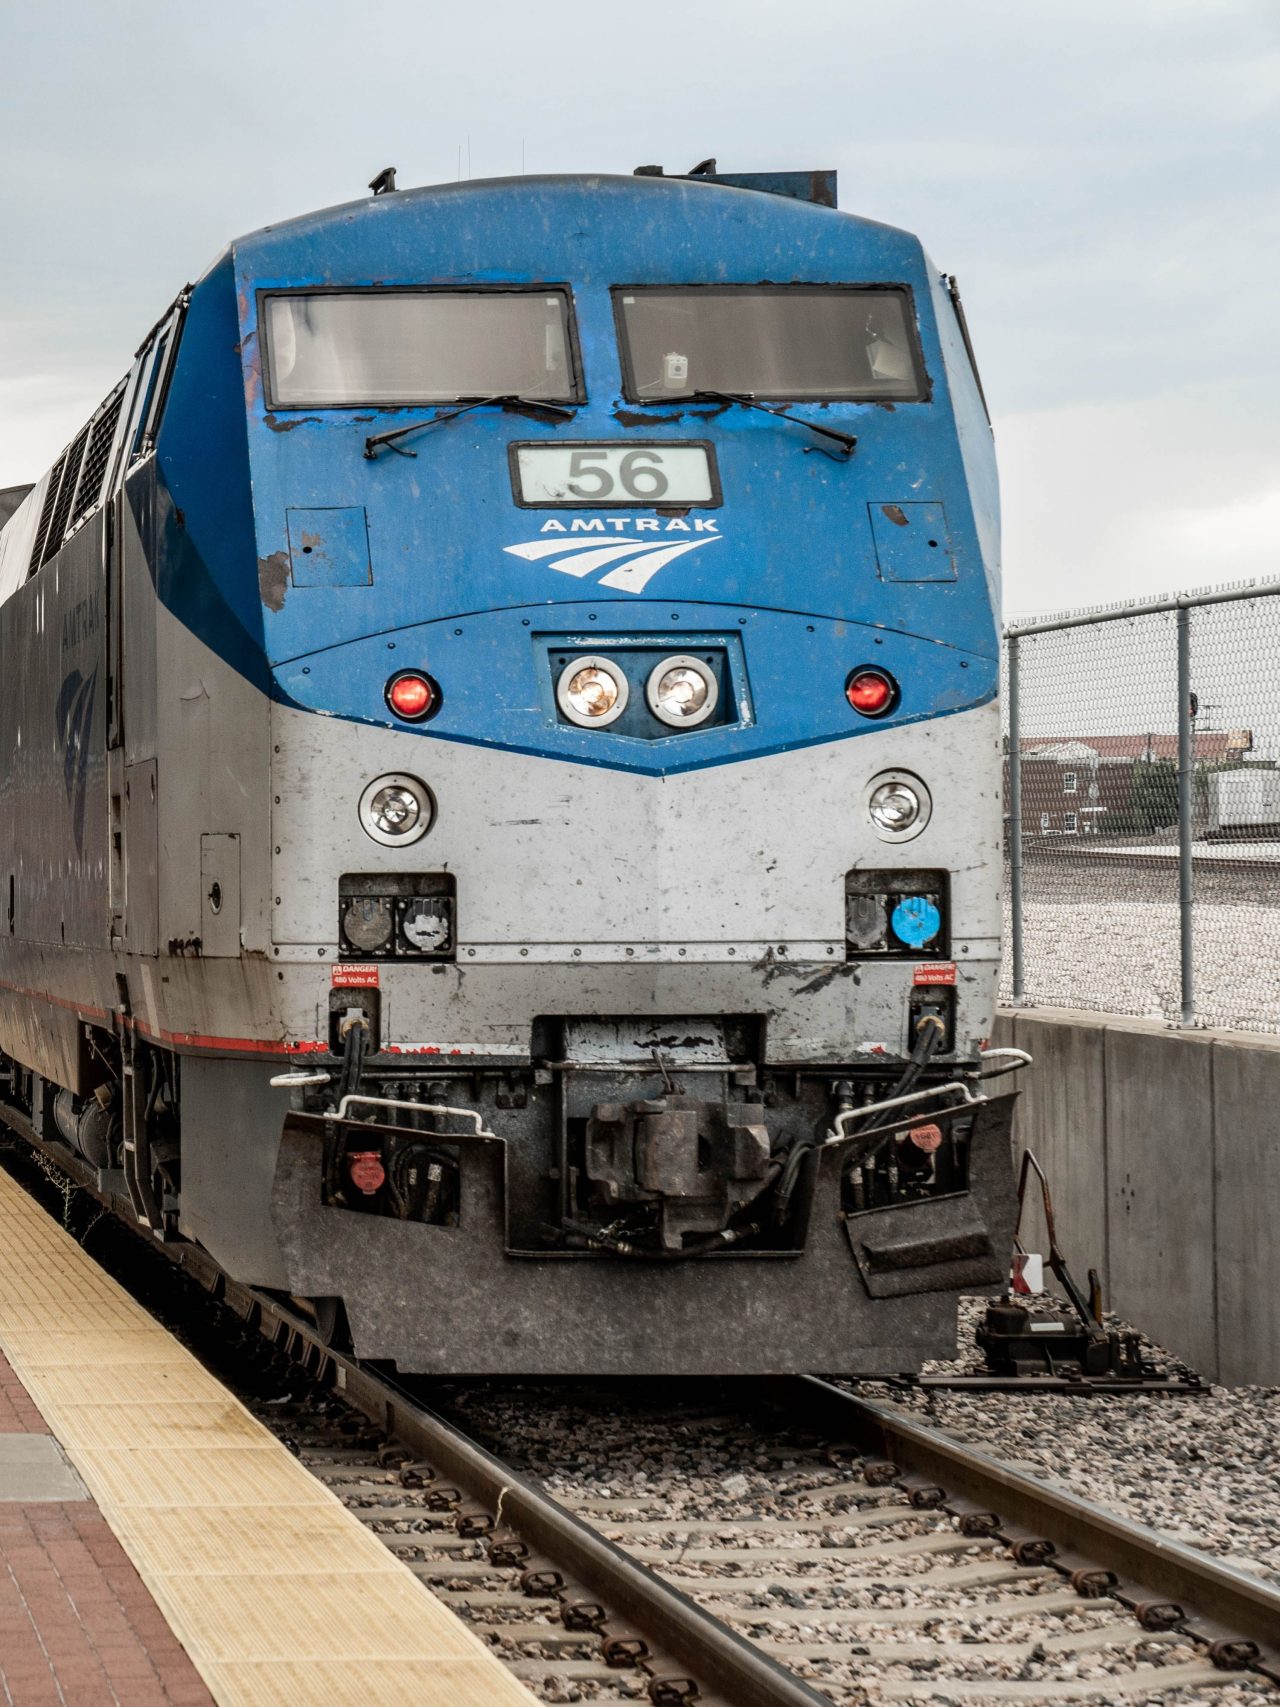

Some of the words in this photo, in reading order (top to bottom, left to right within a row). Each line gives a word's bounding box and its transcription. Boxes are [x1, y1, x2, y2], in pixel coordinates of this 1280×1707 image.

[567, 451, 669, 499] 56
[540, 518, 720, 532] AMTRAK
[342, 965, 378, 973] DANGER!
